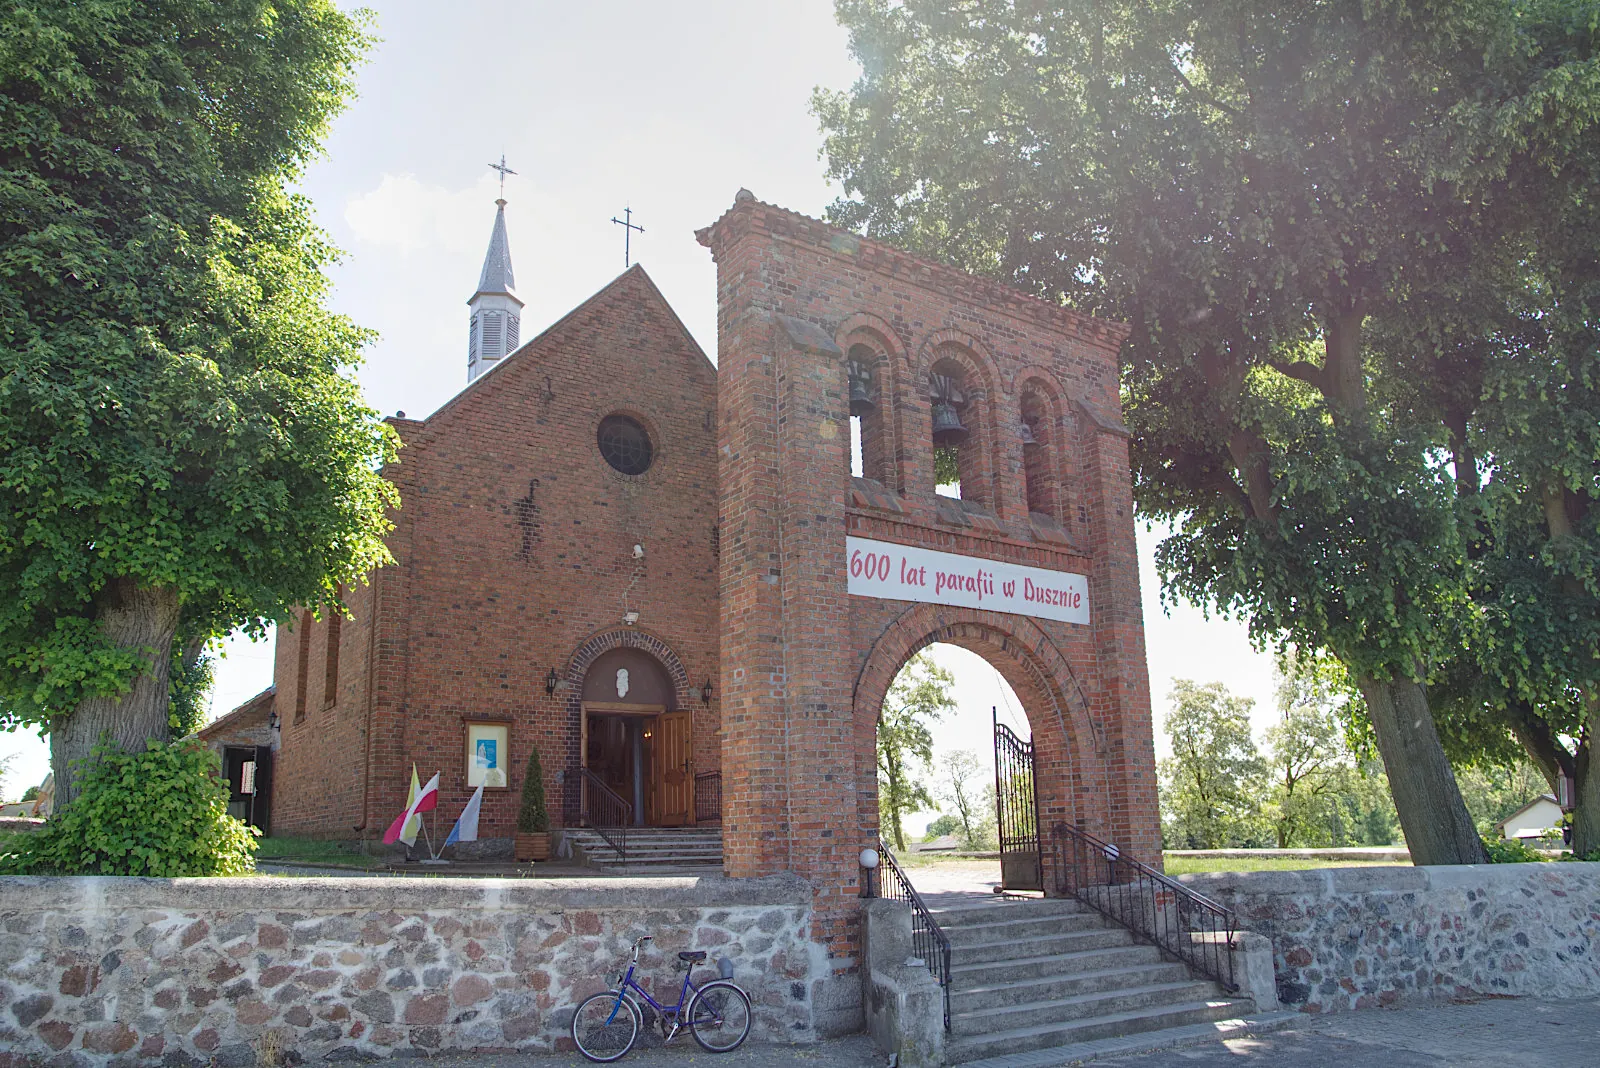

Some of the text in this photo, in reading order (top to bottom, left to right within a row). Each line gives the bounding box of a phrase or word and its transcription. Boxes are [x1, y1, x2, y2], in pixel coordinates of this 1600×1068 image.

[850, 549, 1081, 609] 600 lat parafii w Dusznie
